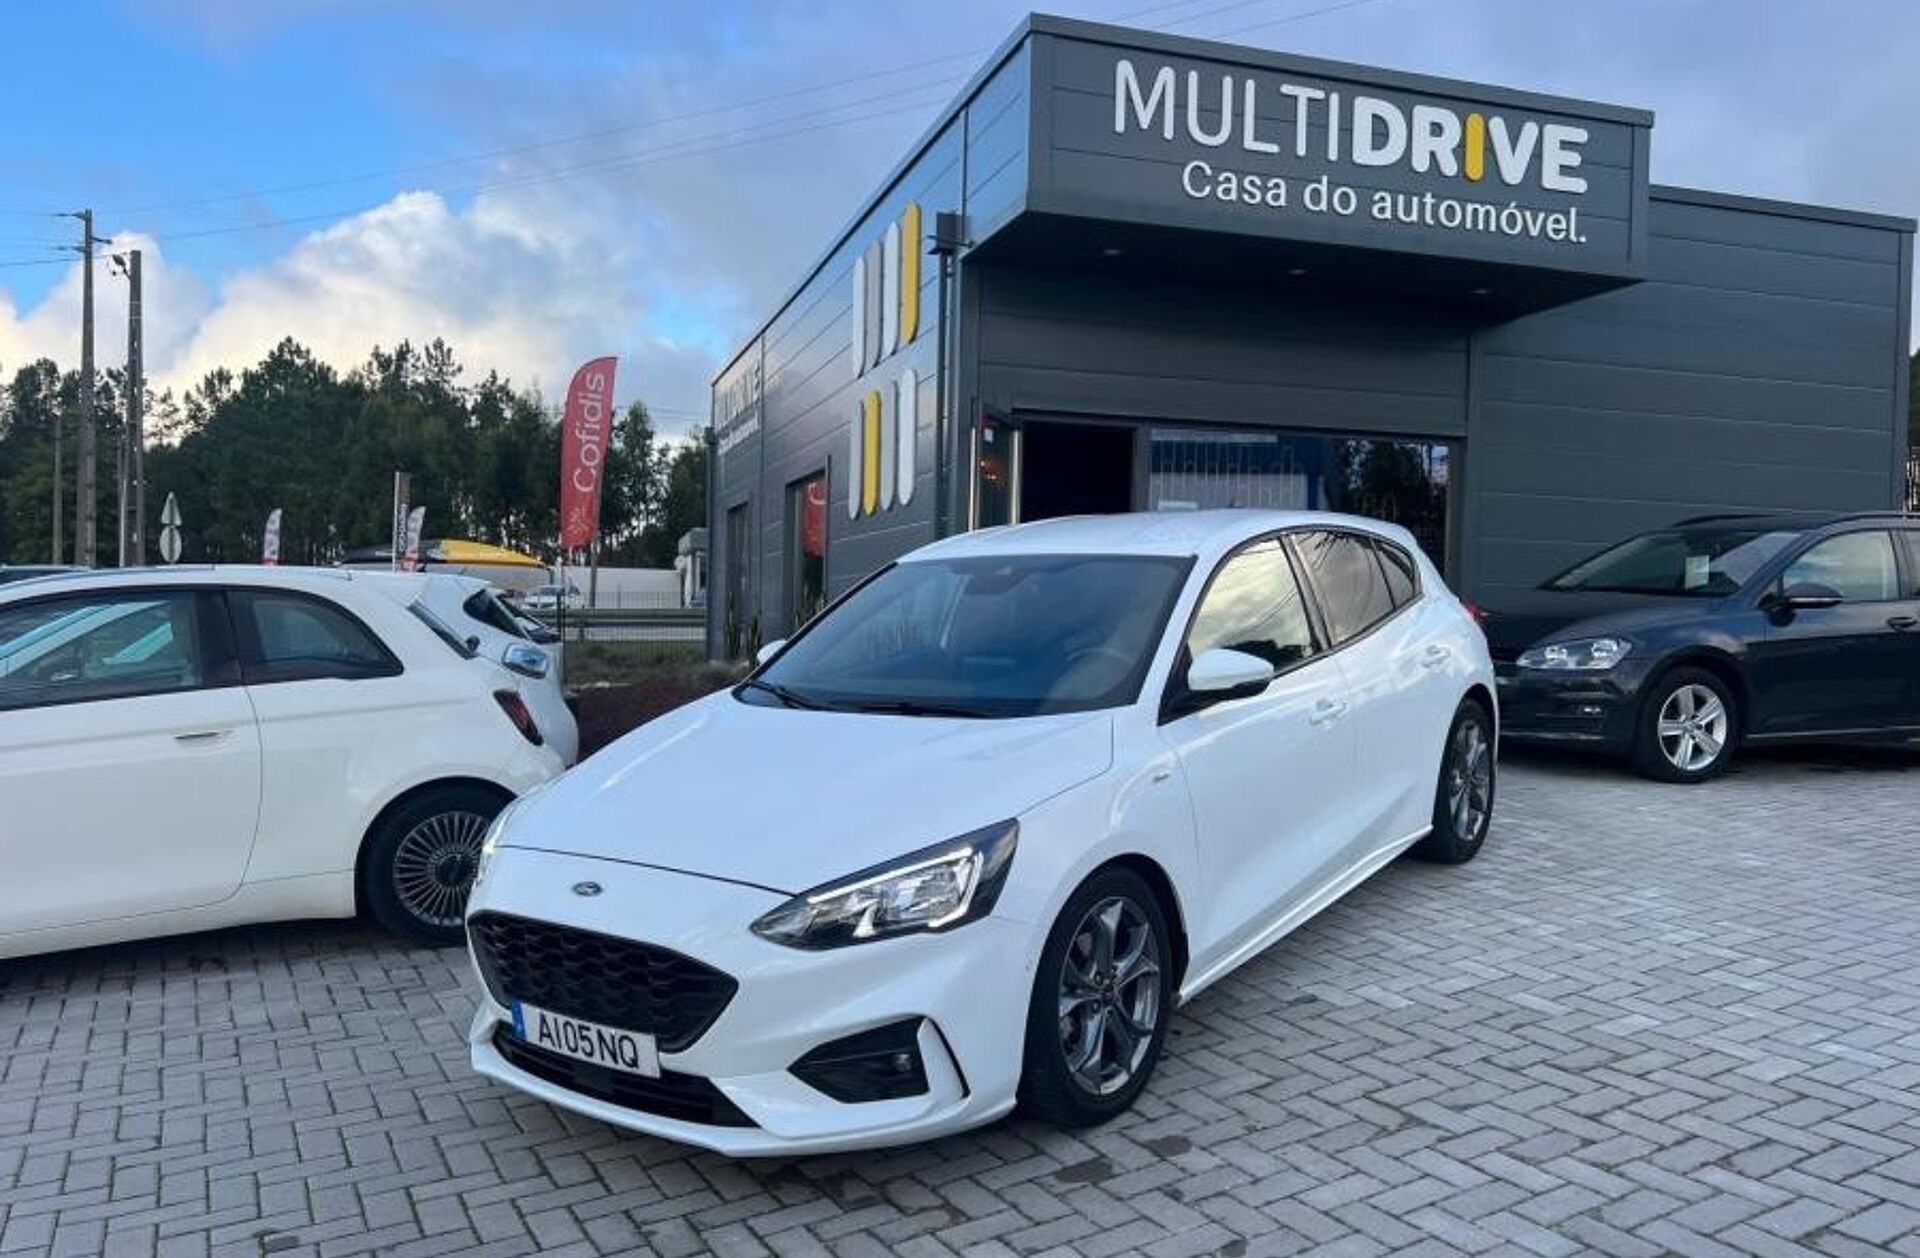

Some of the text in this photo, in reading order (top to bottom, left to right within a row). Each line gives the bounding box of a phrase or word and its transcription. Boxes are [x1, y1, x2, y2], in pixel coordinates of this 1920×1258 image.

[1114, 60, 1588, 193] MULTIDRIVE
[1182, 161, 1587, 243] Casa do automóvel.
[573, 372, 605, 492] Cofidis
